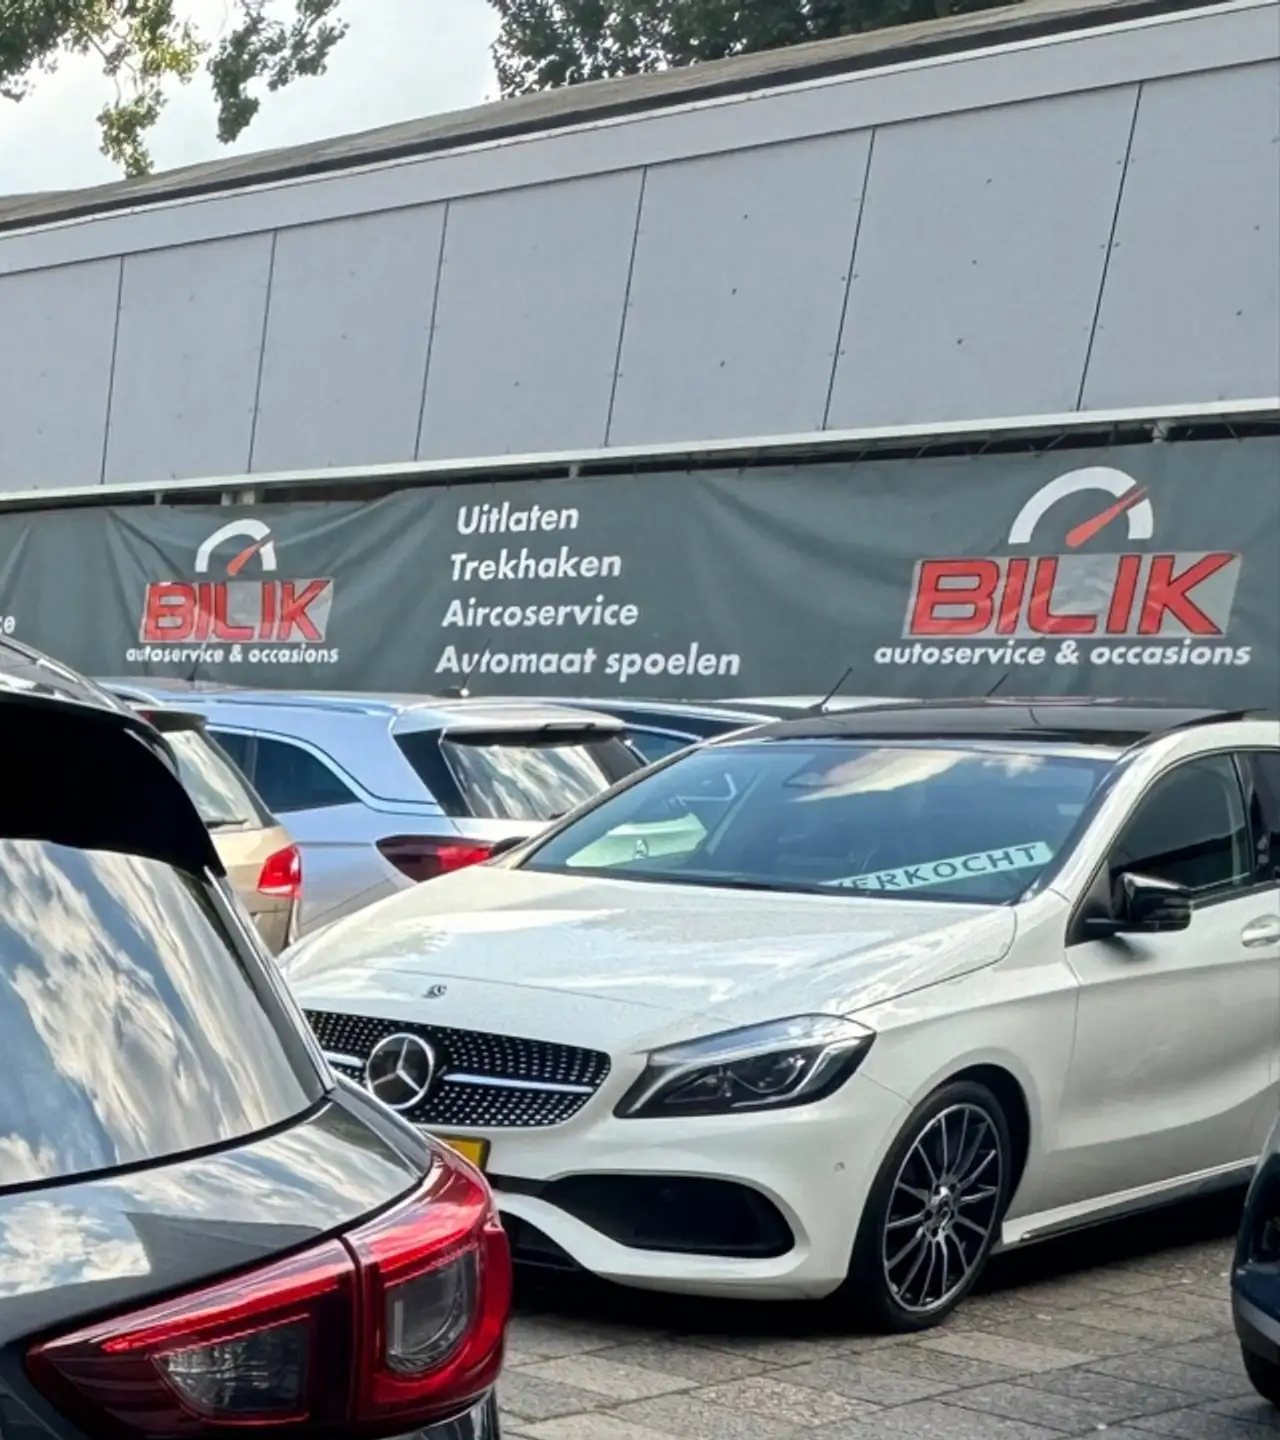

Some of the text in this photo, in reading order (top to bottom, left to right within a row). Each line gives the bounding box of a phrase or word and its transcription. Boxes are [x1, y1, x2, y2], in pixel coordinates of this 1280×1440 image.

[456, 501, 580, 535] Uitlaten
[450, 546, 622, 581] Trekhaken
[143, 579, 331, 642] BILIK
[441, 594, 640, 627] Aircoservice
[909, 552, 1237, 636] BILIK
[125, 643, 339, 664] autoservice & occasions
[435, 642, 741, 683] Automaat spoelen
[874, 637, 1251, 666] autoservice & occasions
[838, 844, 1037, 890] ERKOCHT
